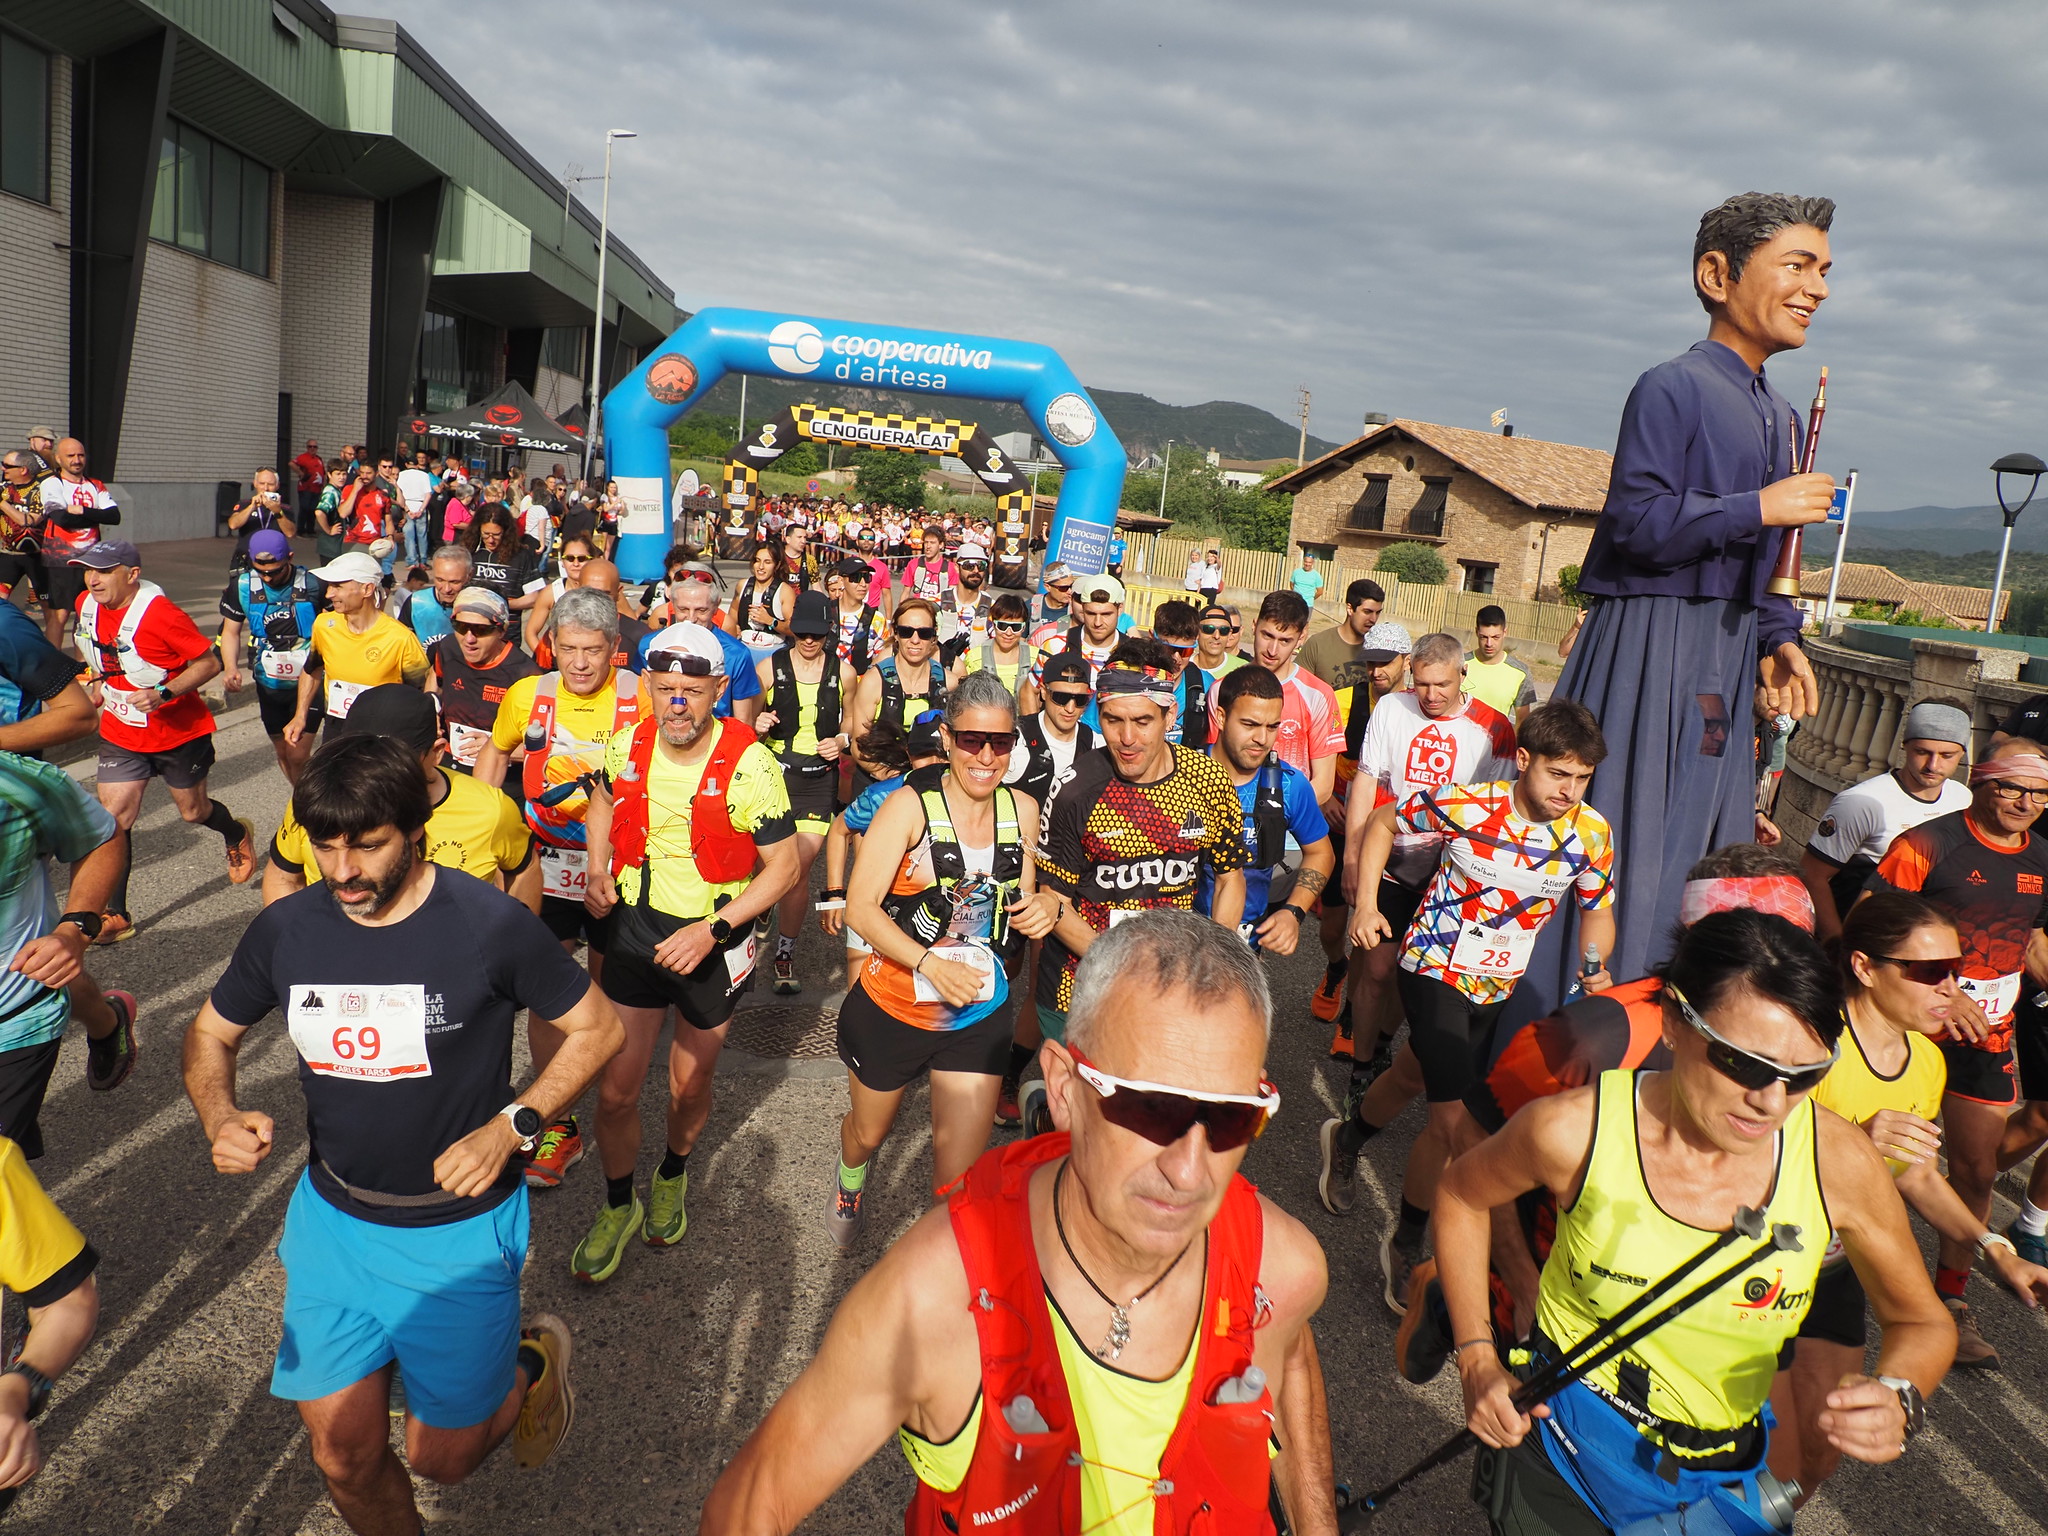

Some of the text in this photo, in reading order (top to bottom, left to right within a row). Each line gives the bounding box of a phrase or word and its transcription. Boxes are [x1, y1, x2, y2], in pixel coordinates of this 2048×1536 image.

[832, 334, 992, 370] cooperativa
[835, 358, 947, 390] d'artesa
[428, 424, 481, 441] 24MX
[811, 421, 952, 449] CCNOGUERA.CAT
[517, 437, 568, 451] 24MX
[633, 503, 661, 512] MONTSEC
[1067, 527, 1107, 543] agrocamp
[1063, 538, 1103, 556] artesa
[476, 565, 507, 579] PONS
[276, 663, 294, 675] 39
[111, 700, 129, 716] 29
[1416, 737, 1453, 752] TRAIL
[1410, 747, 1451, 773] LO
[1408, 769, 1450, 786] MELÓ
[1038, 766, 1077, 846] CUDOS
[451, 840, 463, 849] NO
[560, 869, 587, 889] 34
[1095, 855, 1199, 890] CUDOS
[952, 912, 975, 922] CIAL
[1479, 949, 1512, 968] 28
[1466, 966, 1487, 974] DANIEL
[441, 1022, 463, 1032] FUTURE
[332, 1026, 381, 1061] 69
[332, 1064, 362, 1075] CARLES
[972, 1483, 1039, 1527] SALOMON
